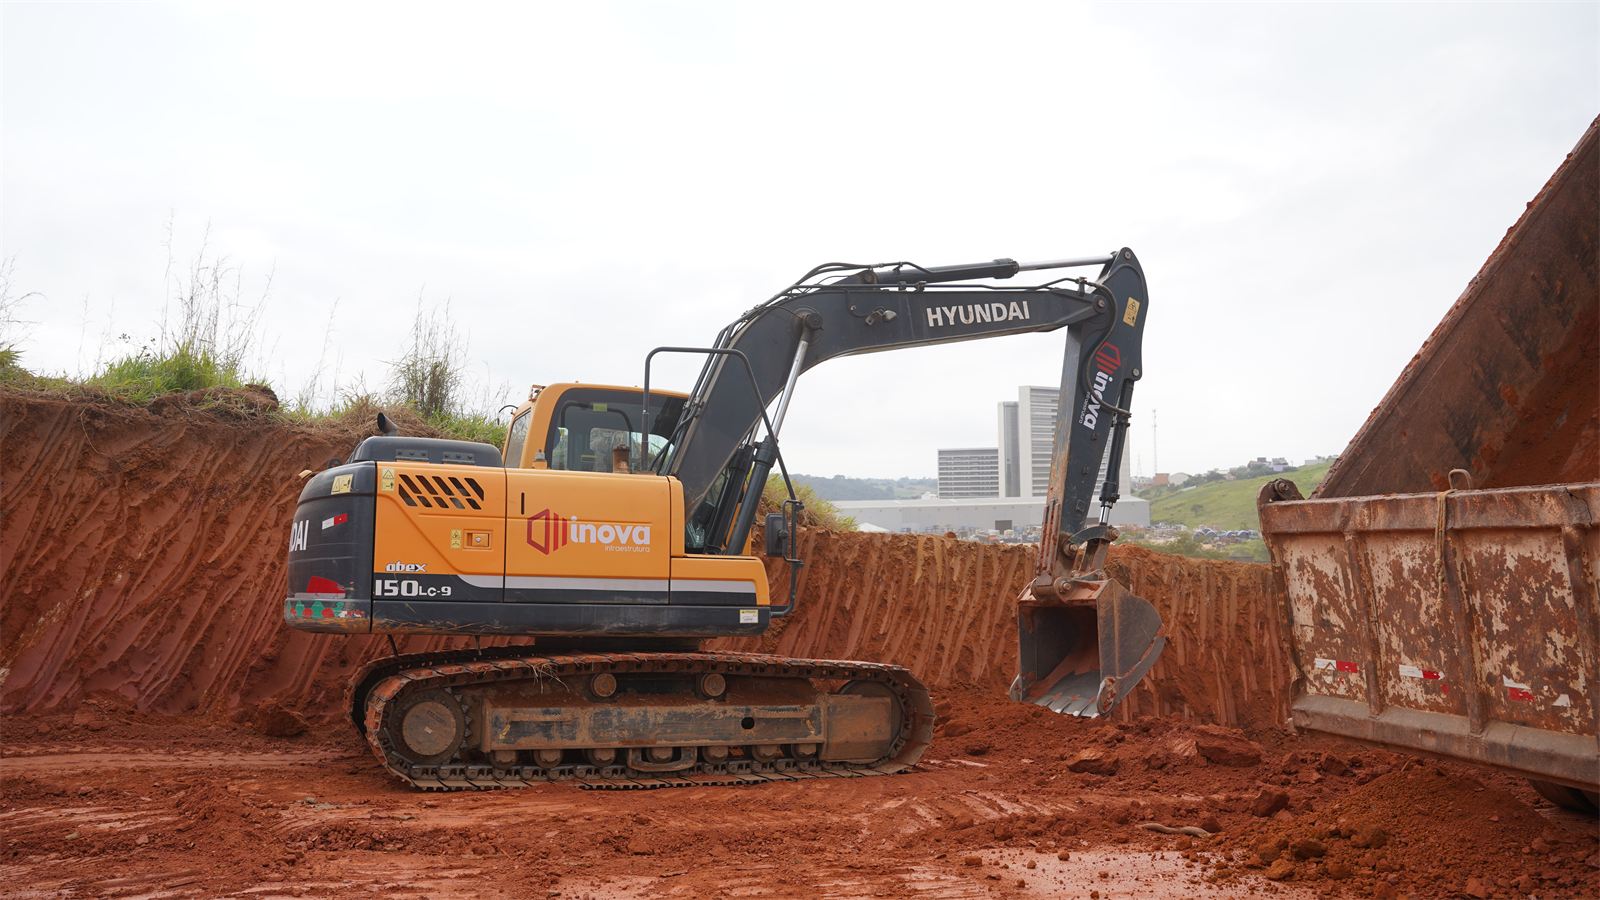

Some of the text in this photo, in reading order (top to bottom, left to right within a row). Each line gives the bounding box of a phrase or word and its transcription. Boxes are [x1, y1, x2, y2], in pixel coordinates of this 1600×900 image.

[926, 301, 1030, 327] HYUNDAI
[1083, 371, 1113, 430] inova
[571, 515, 651, 544] inova
[604, 545, 650, 553] infraestrutura
